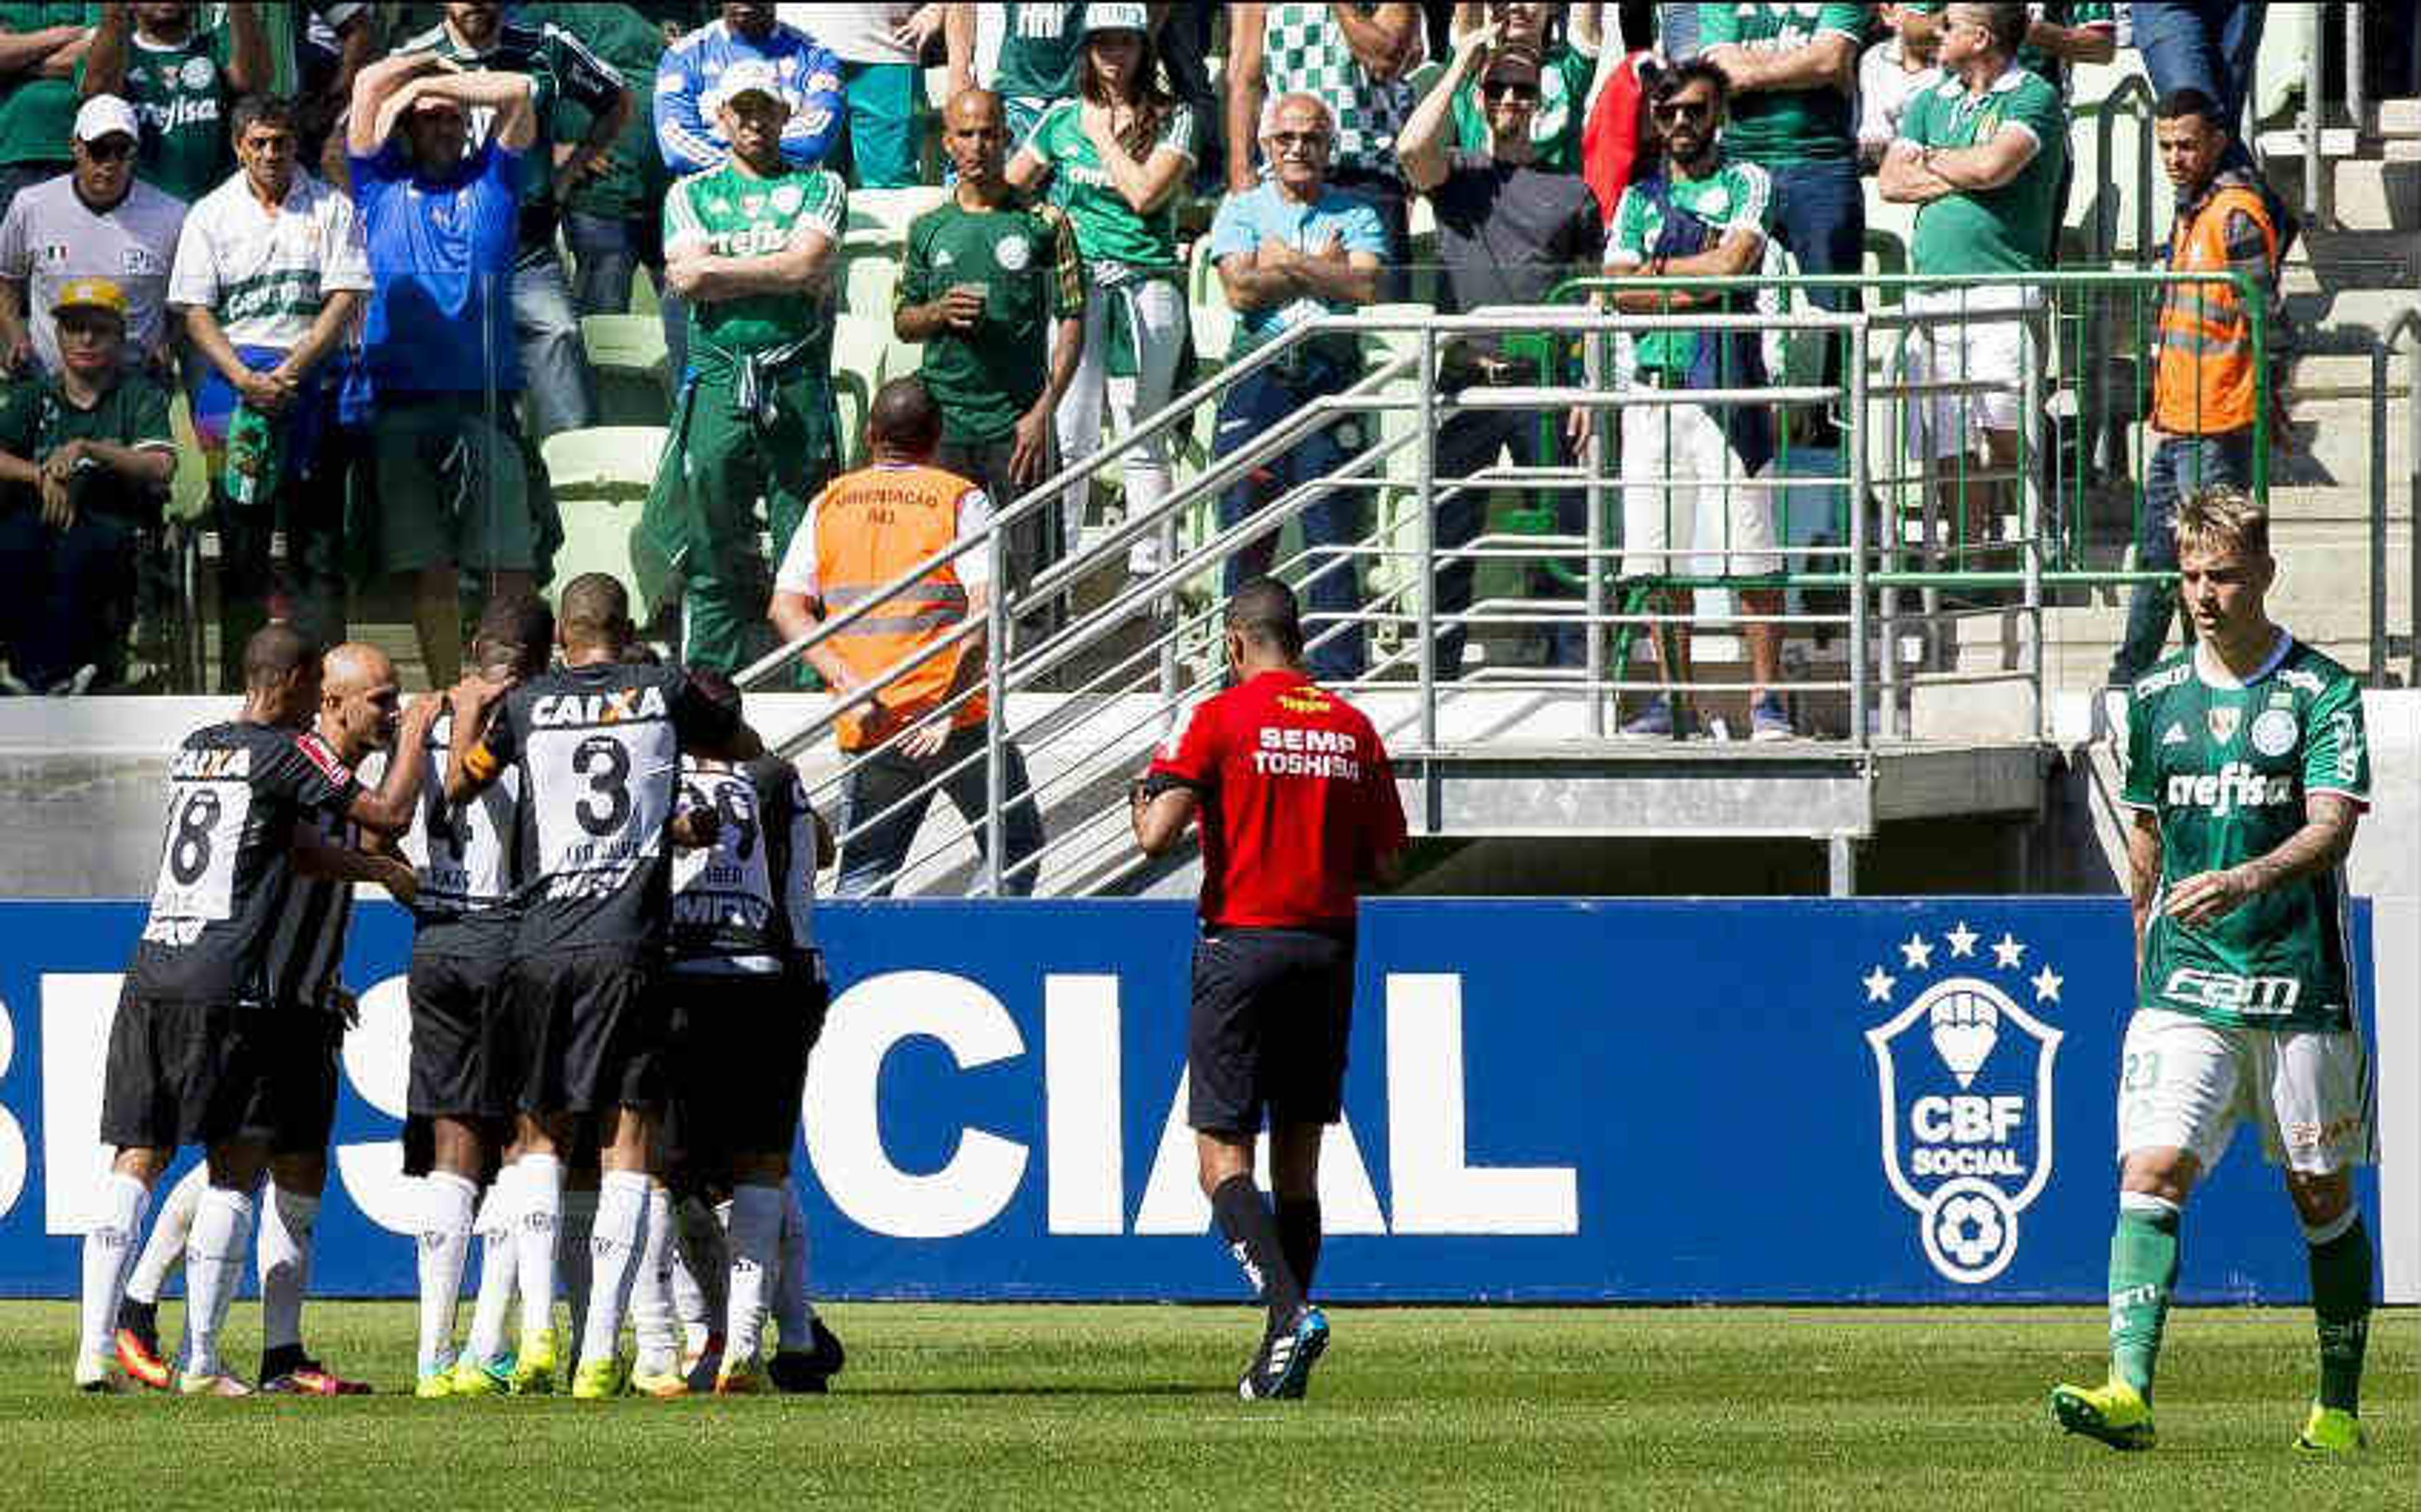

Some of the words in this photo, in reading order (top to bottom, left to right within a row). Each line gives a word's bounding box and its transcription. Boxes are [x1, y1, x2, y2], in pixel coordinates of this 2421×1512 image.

[531, 686, 667, 725] CAIXA
[1260, 727, 1356, 754] SEMP
[572, 735, 631, 836] 3
[2168, 760, 2294, 817] crefisa
[171, 789, 221, 886] 8
[1912, 1095, 2024, 1144] CBF
[1912, 1147, 2026, 1176] SOCIAL
